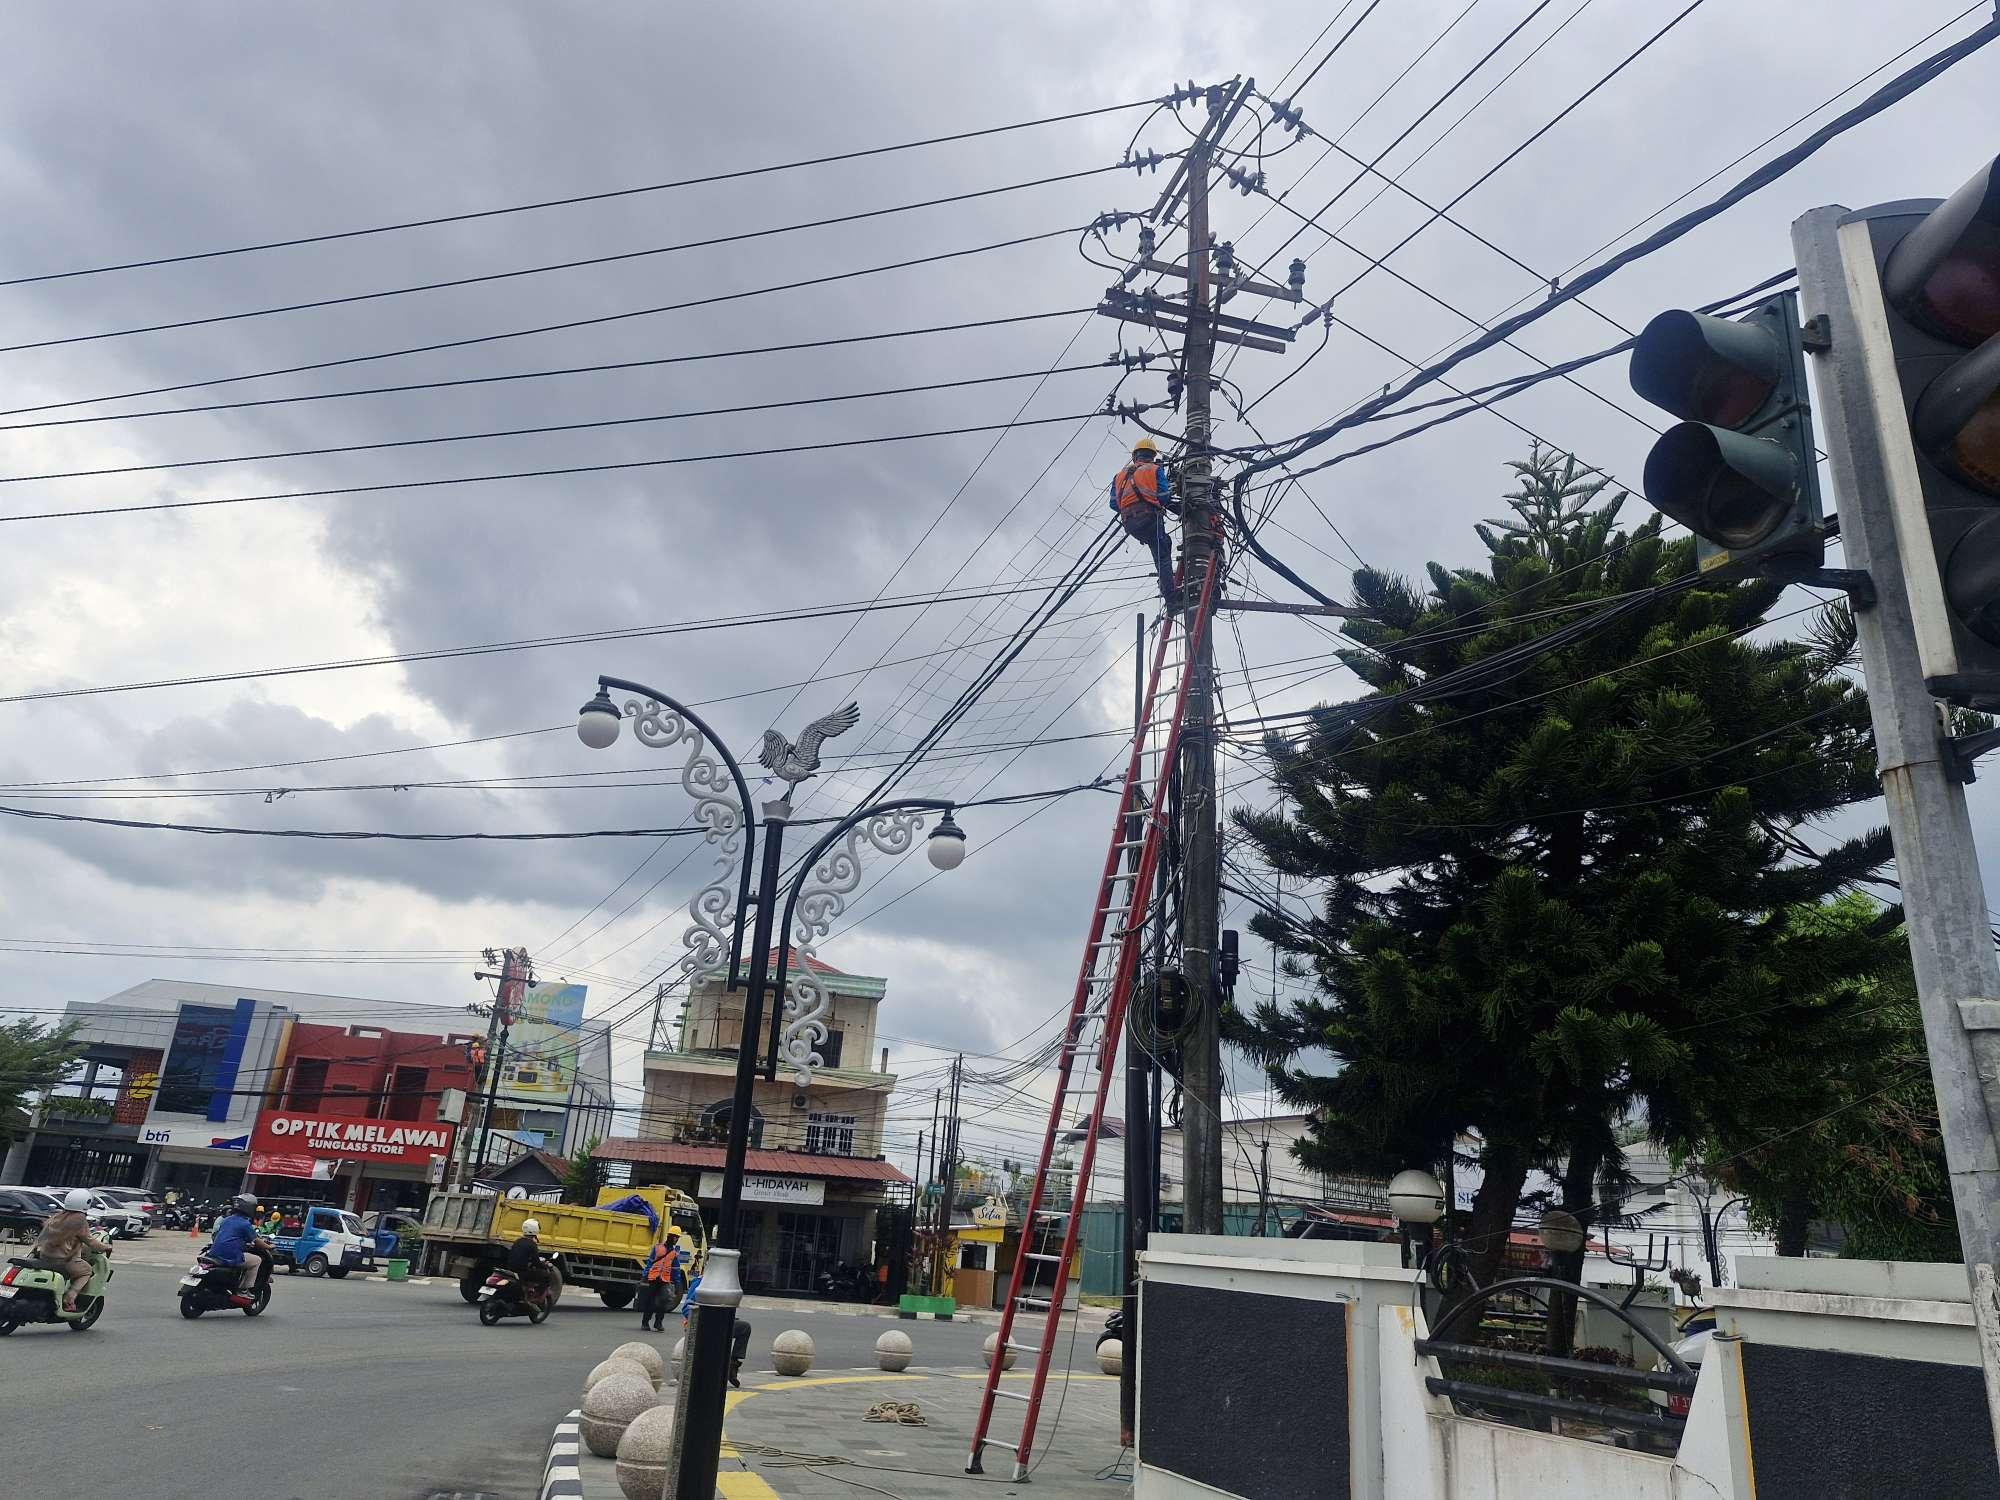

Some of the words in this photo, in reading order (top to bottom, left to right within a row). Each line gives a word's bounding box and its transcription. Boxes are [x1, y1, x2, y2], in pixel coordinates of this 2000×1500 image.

[145, 1129, 172, 1142] btn
[271, 1118, 343, 1140] OPTIK
[345, 1124, 448, 1148] MELAWAI
[308, 1138, 368, 1152] SUNGLASS
[370, 1143, 405, 1155] STORE
[742, 1177, 809, 1192] L-HIDAYAH
